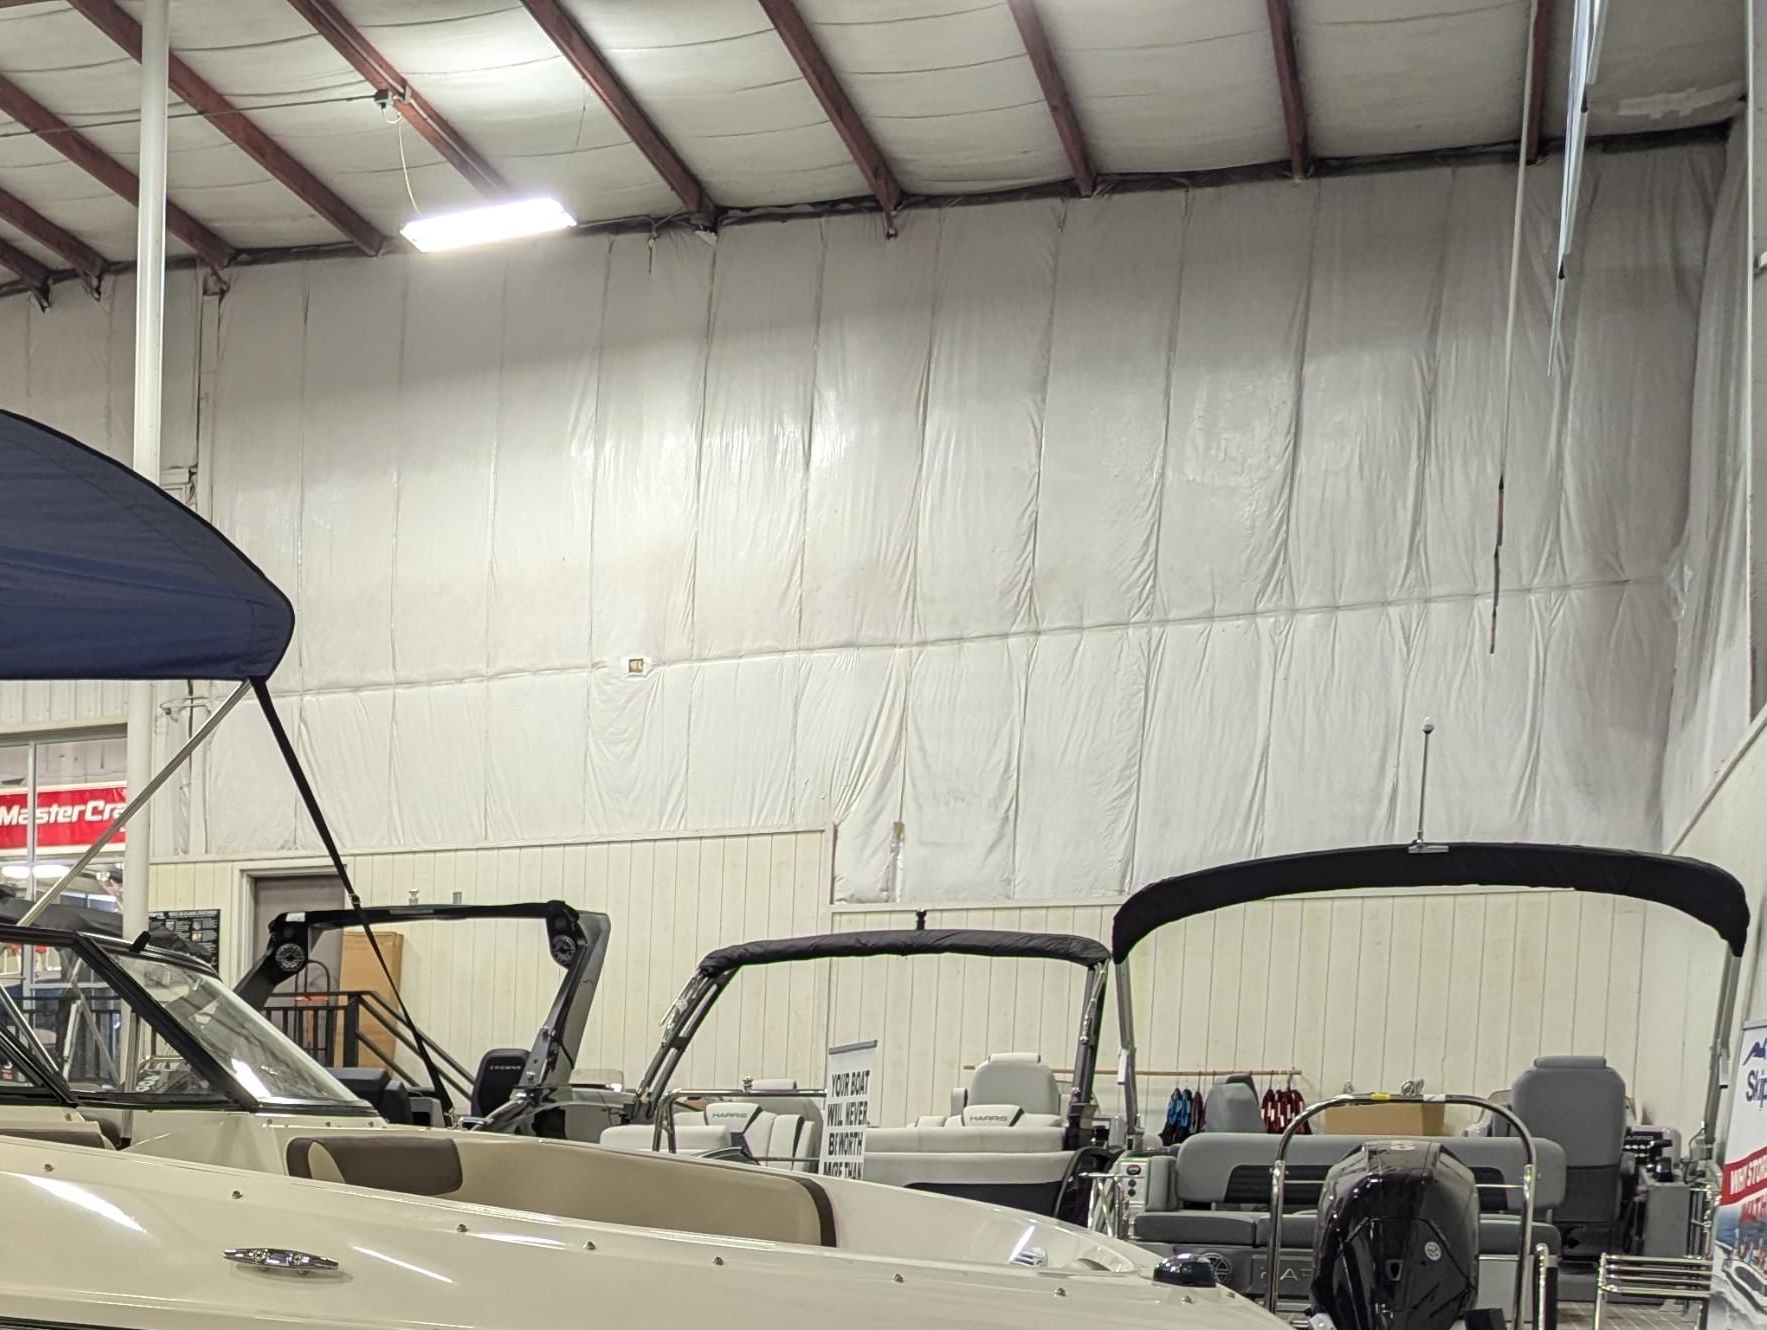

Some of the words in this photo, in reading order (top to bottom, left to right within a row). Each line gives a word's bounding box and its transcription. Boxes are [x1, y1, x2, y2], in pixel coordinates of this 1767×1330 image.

[831, 1073, 850, 1098] YOUR
[850, 1070, 870, 1096] BOAT
[827, 1103, 843, 1127] WILL
[845, 1101, 868, 1126] NEVER
[838, 1131, 863, 1156] WORTH
